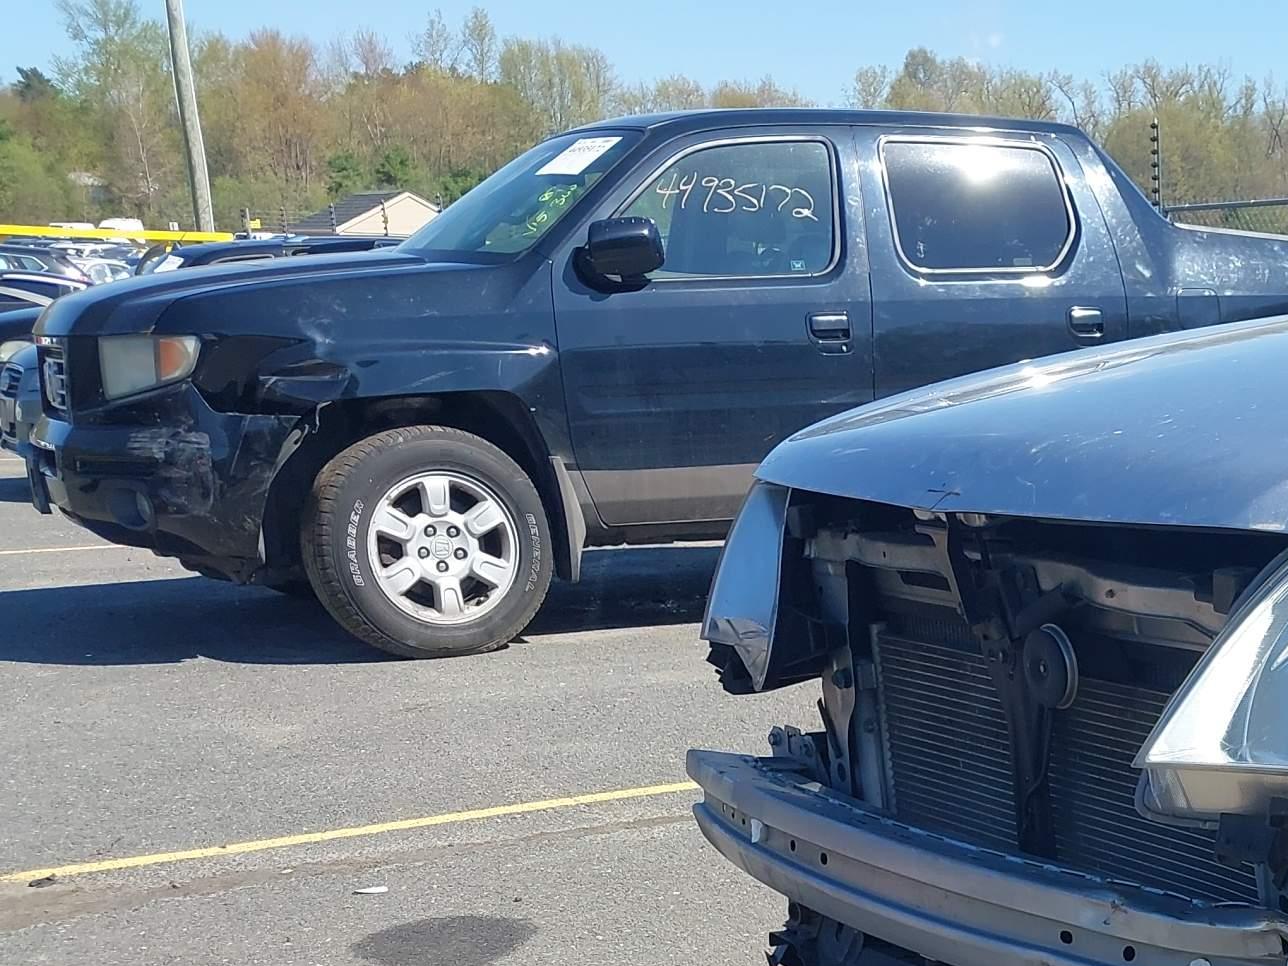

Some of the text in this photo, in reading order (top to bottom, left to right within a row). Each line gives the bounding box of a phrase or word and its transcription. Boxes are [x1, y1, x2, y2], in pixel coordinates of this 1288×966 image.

[656, 171, 818, 222] 44935172
[346, 499, 365, 586] GRABBER
[525, 513, 542, 592] GENERAL
